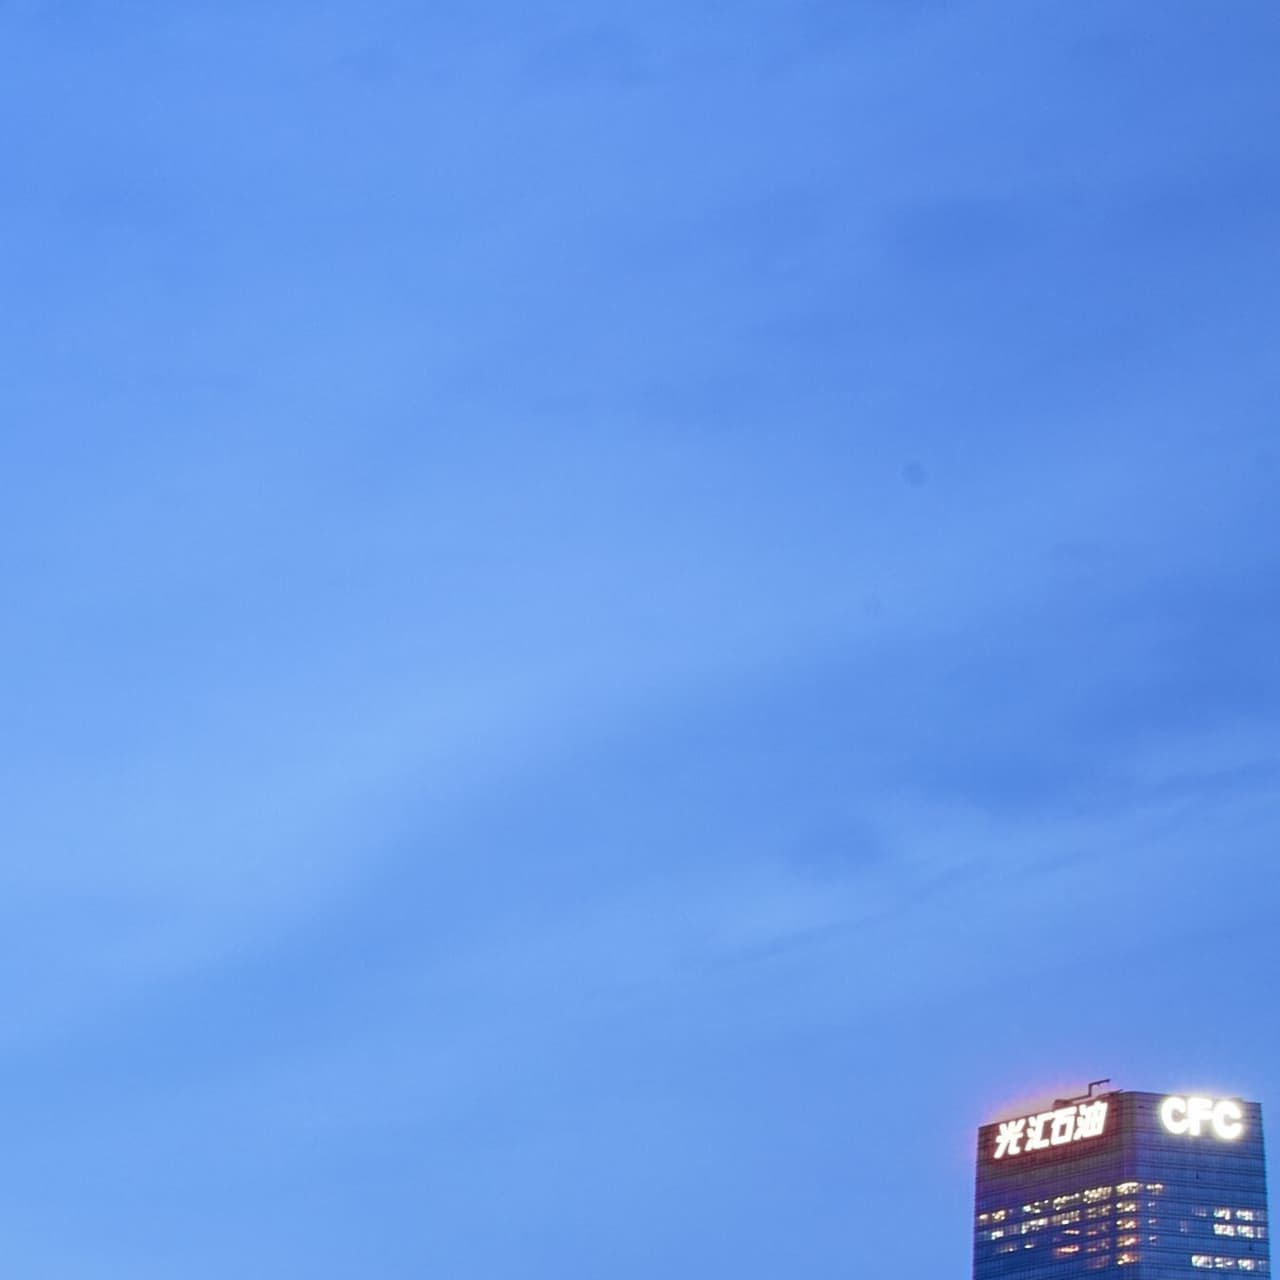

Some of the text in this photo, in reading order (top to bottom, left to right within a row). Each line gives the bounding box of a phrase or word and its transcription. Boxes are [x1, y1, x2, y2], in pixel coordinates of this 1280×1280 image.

[993, 1100, 1109, 1159] 光汇石油
[1160, 1096, 1244, 1139] CFC
